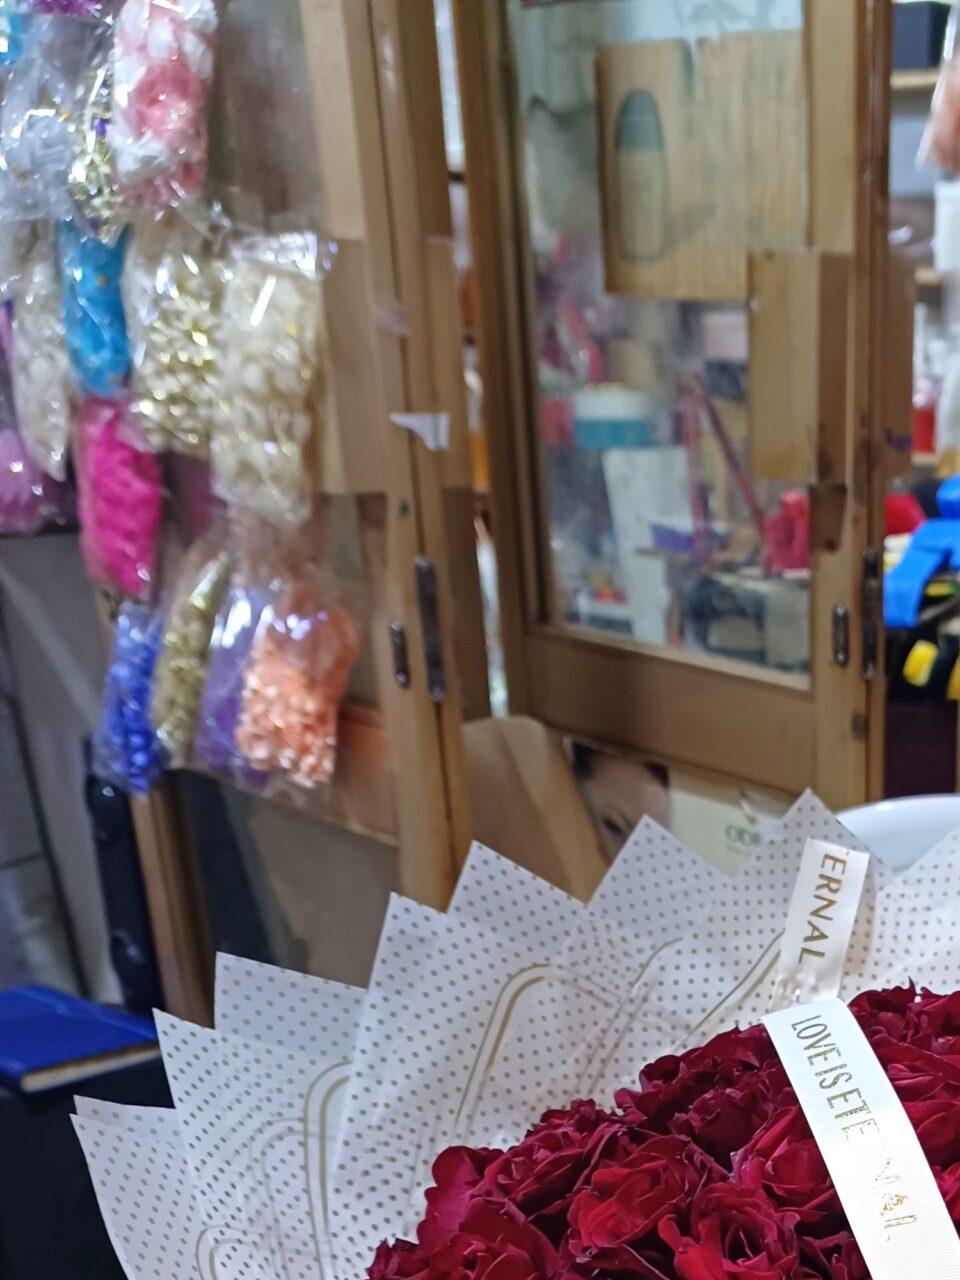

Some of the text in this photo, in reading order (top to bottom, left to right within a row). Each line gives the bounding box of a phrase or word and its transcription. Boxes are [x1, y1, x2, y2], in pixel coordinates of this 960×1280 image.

[798, 849, 849, 964] ERNAL
[791, 1014, 842, 1067] LOVE
[814, 1063, 853, 1090] IS
